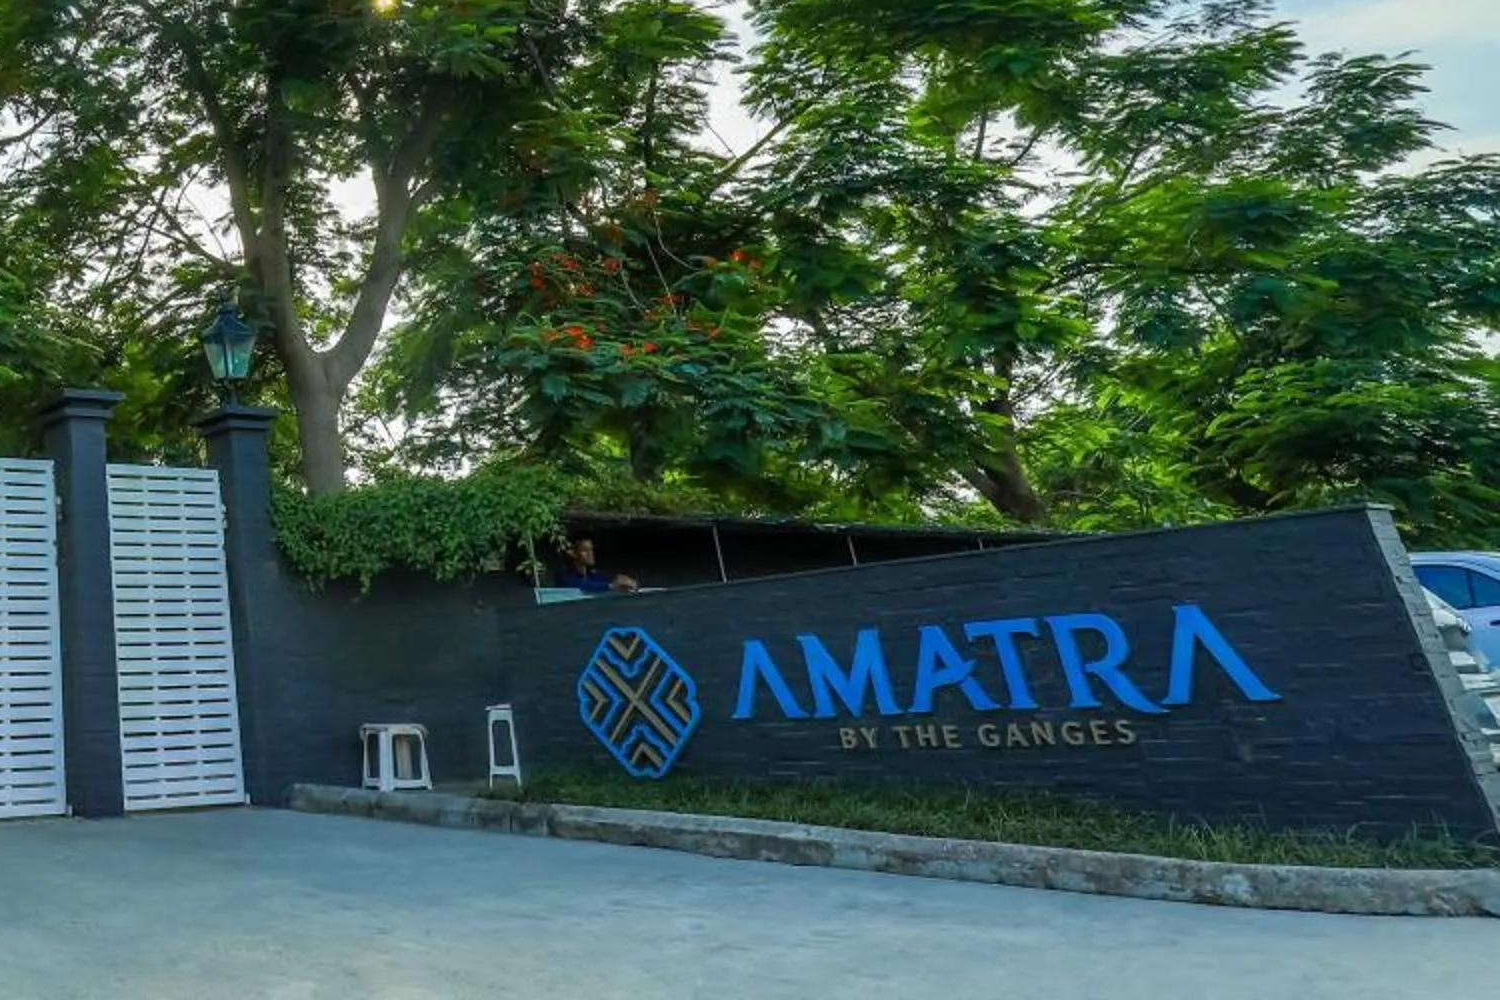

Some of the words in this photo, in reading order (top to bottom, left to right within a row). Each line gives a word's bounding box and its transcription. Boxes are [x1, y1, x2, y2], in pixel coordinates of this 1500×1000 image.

[731, 603, 1282, 719] AMATRA
[839, 726, 879, 750] BY
[893, 723, 963, 749] THE
[977, 719, 1137, 748] GANGES
